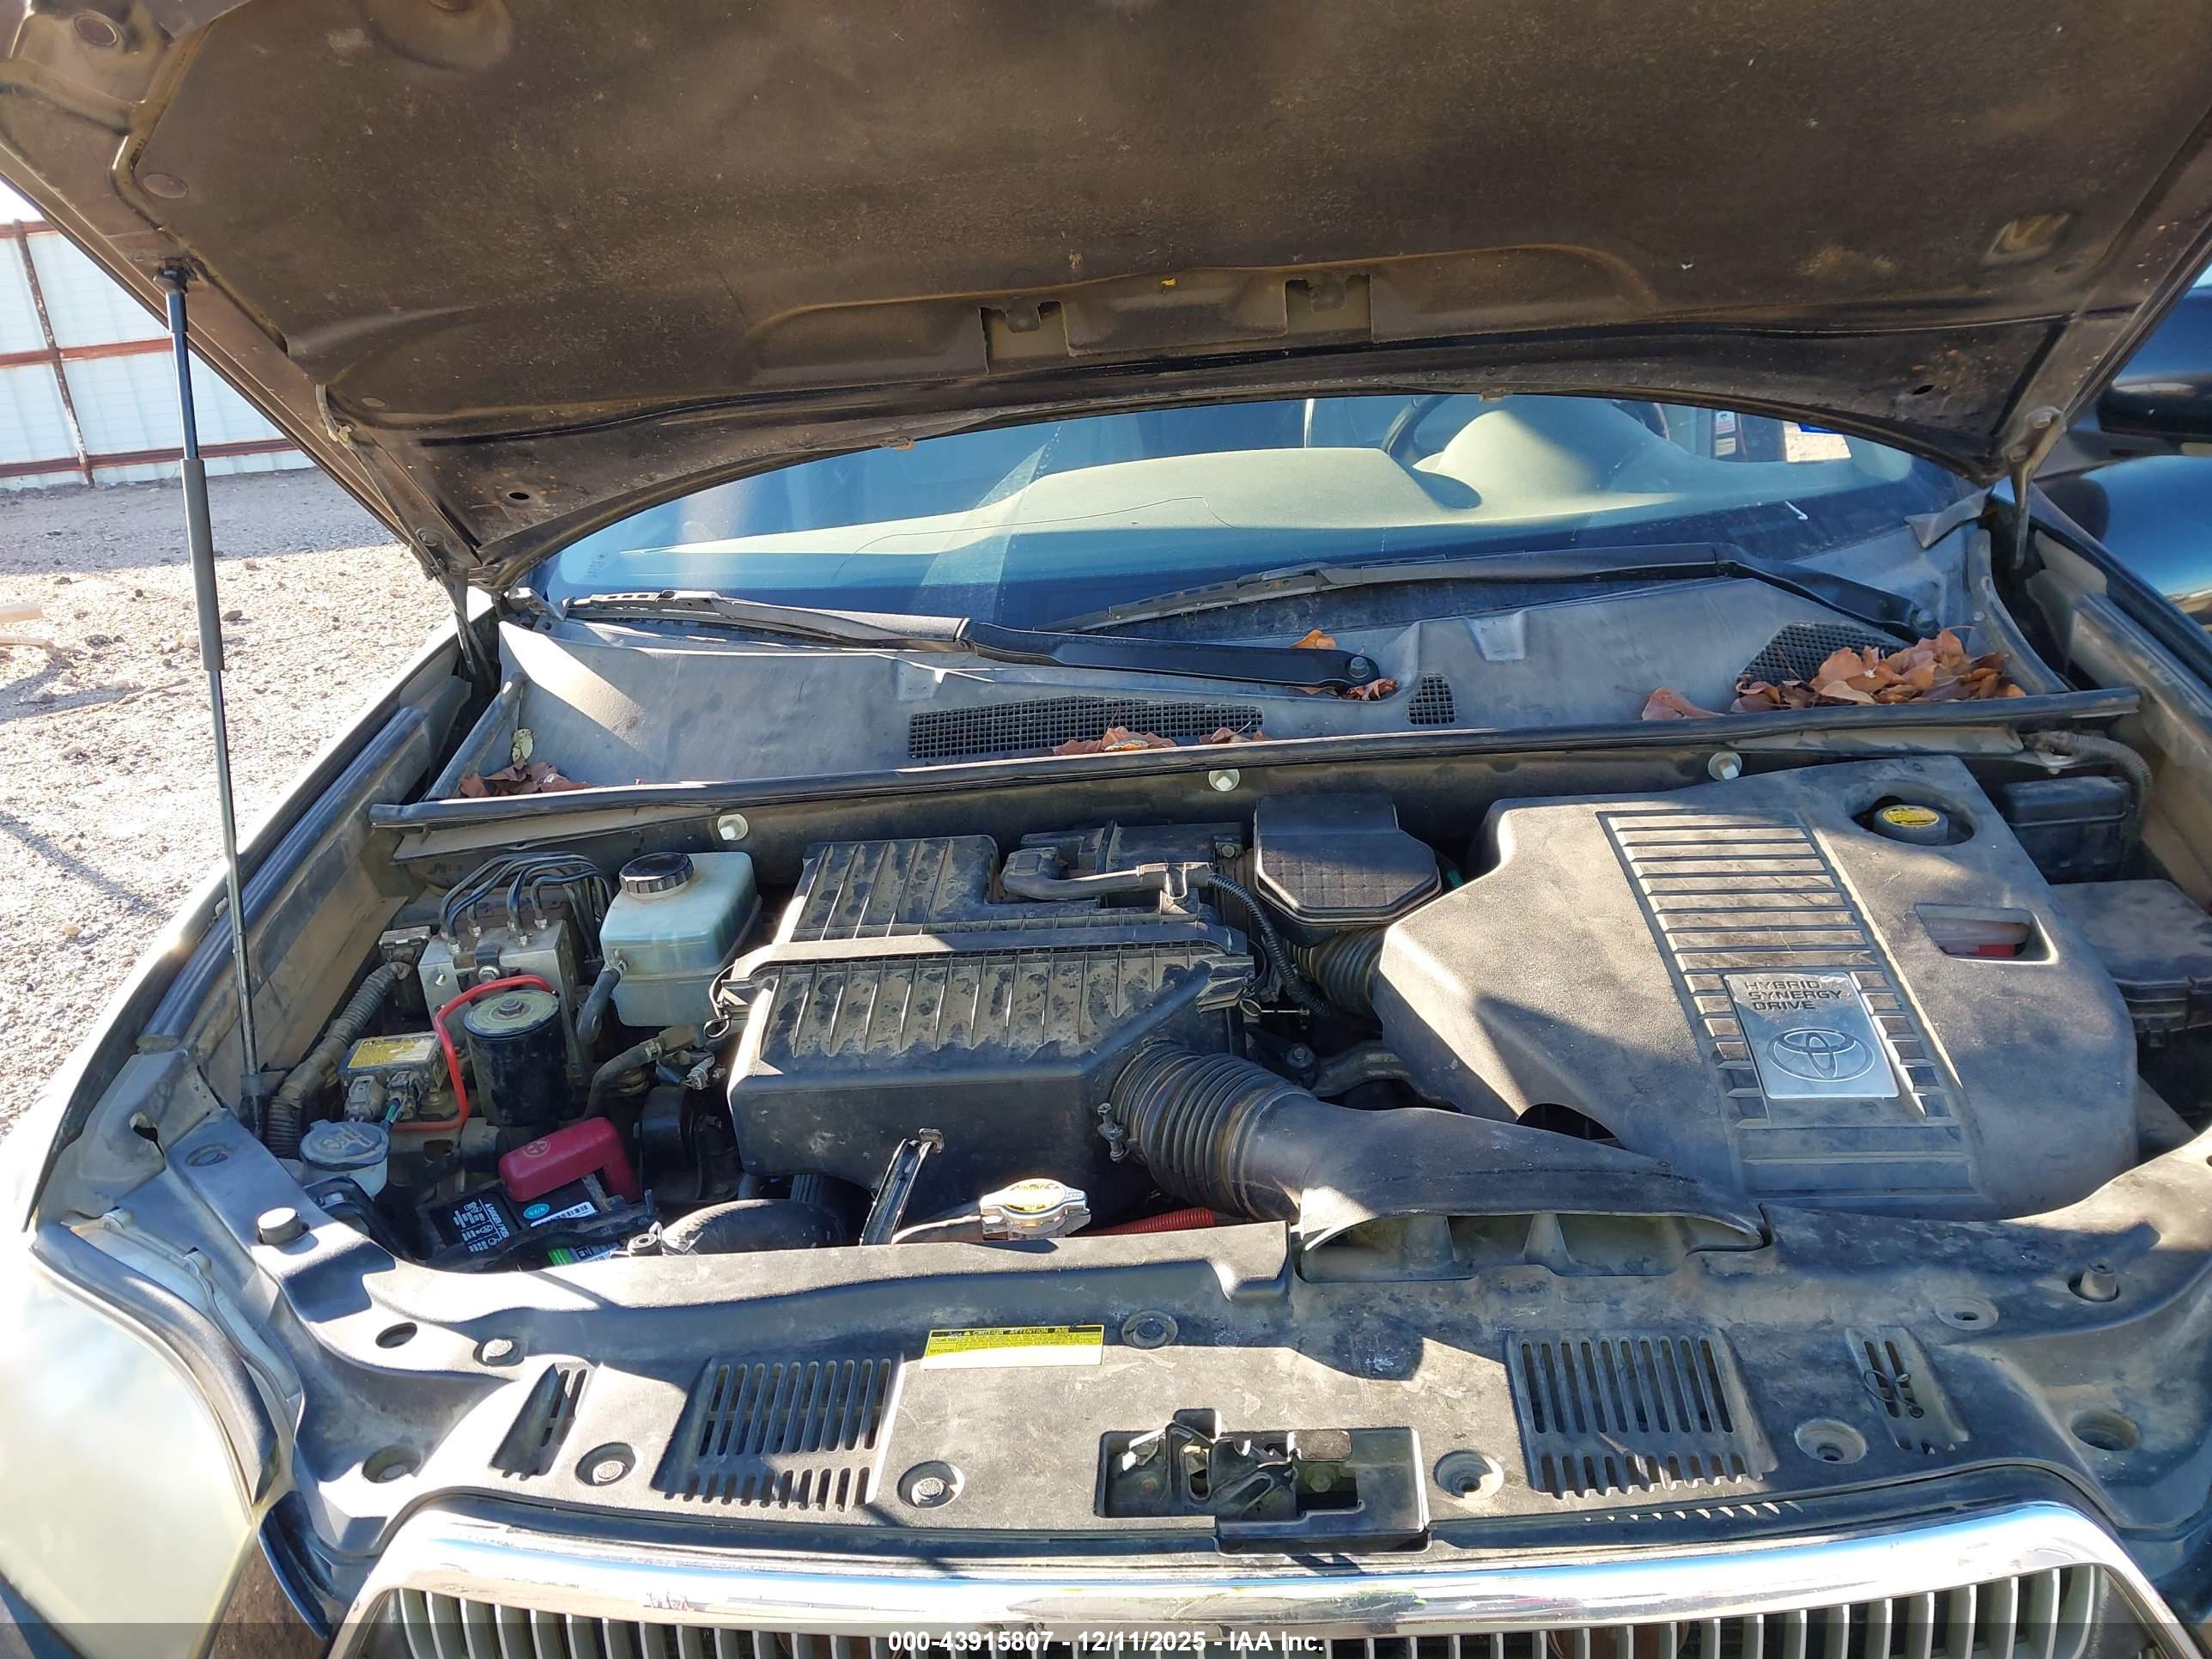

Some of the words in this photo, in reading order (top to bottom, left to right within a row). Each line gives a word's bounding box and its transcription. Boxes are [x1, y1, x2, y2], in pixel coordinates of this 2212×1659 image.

[1744, 981, 1821, 990] HYBRID
[1748, 990, 1842, 1000] SYNERGY
[1753, 1000, 1816, 1011] DRIVE
